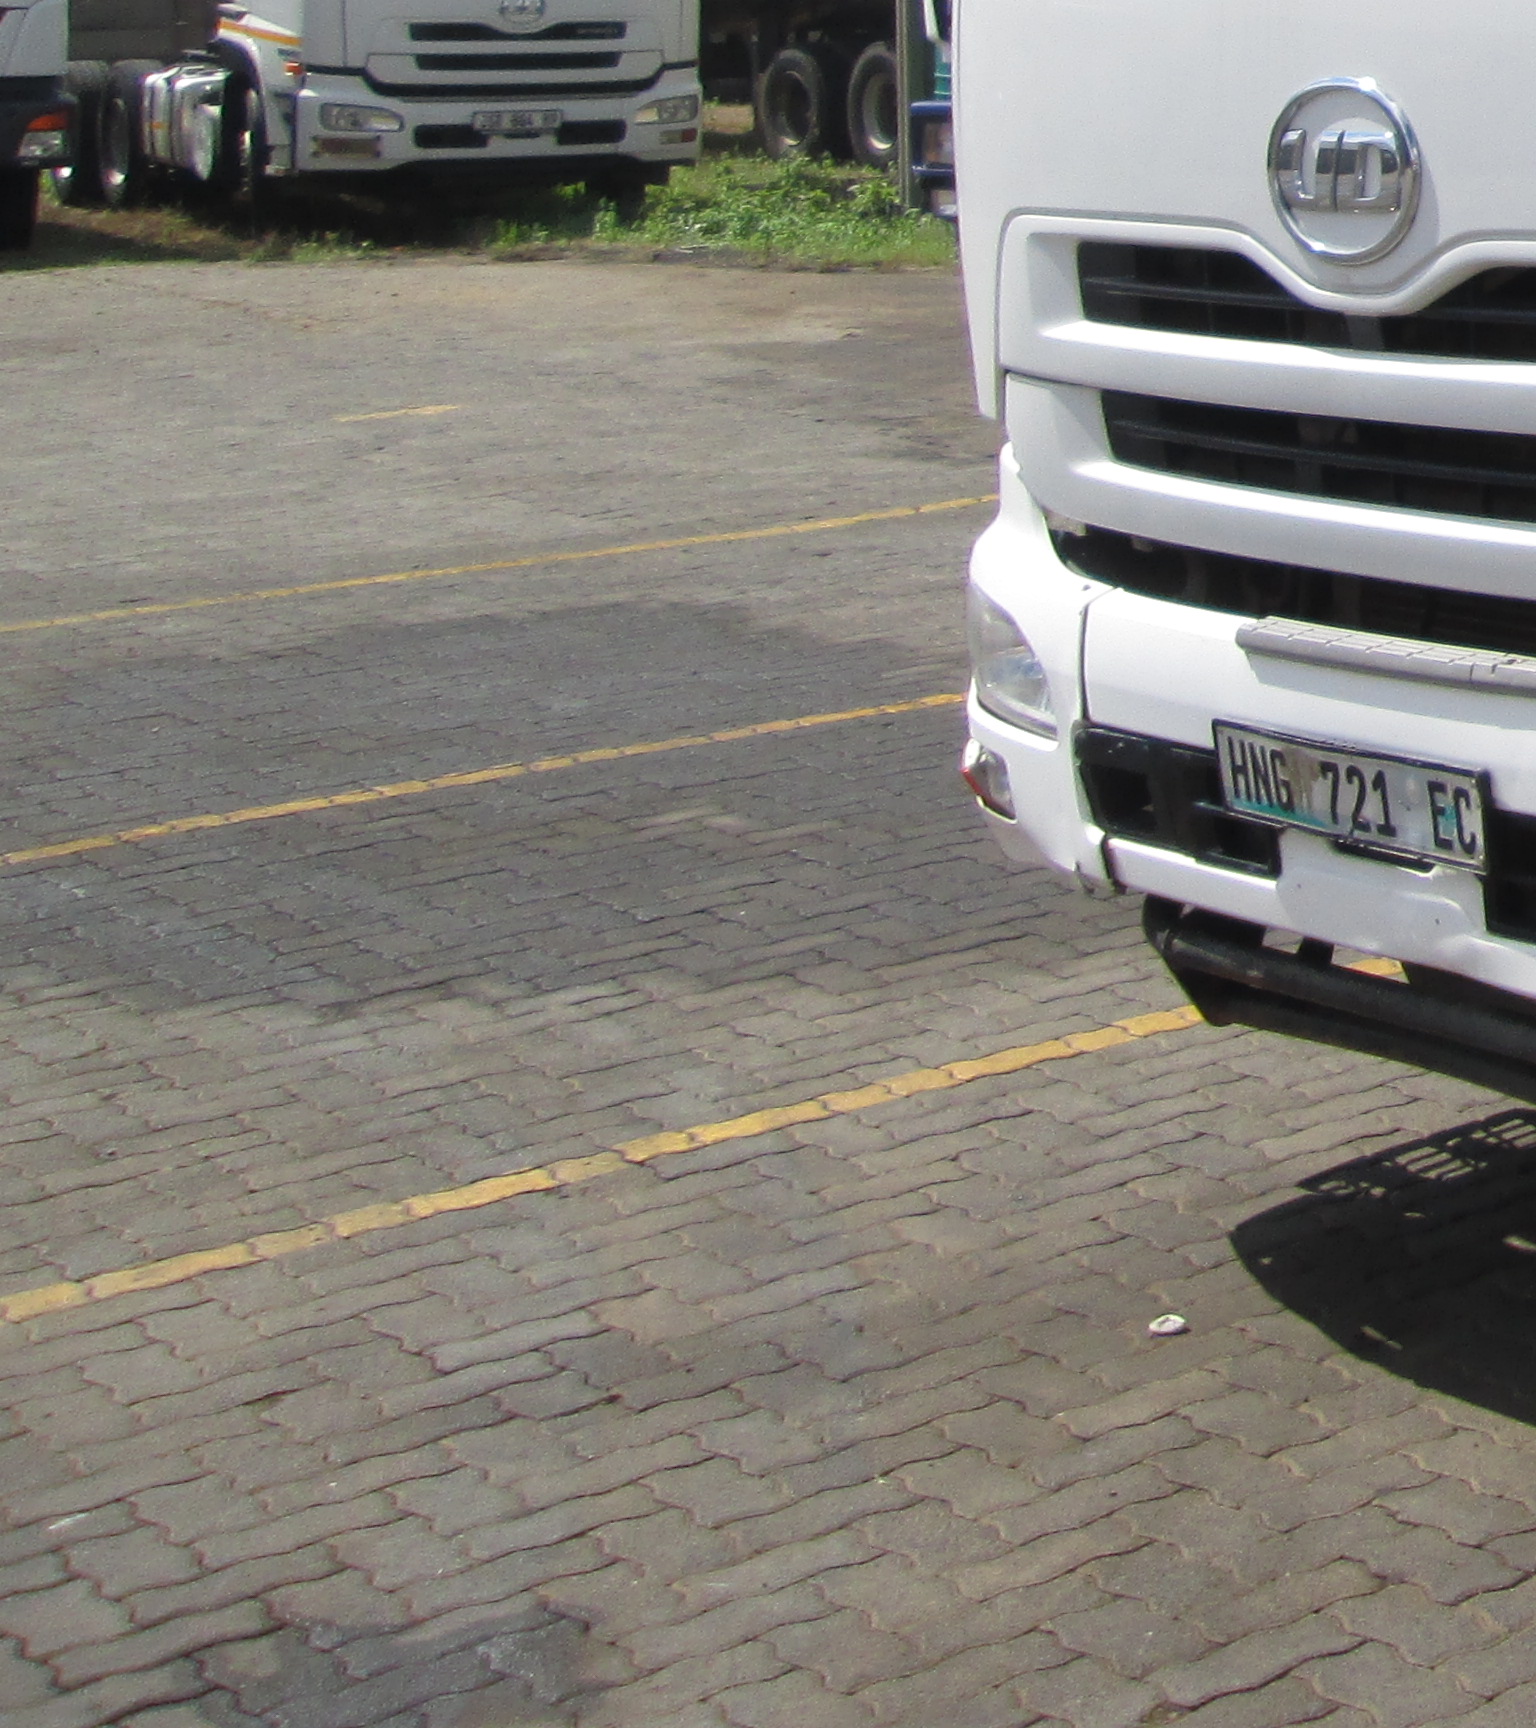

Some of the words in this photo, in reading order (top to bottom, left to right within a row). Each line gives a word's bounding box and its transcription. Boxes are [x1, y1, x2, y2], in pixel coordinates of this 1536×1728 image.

[1226, 734, 1295, 814] HNG
[1319, 759, 1397, 838] 721
[1426, 779, 1477, 856] EC
